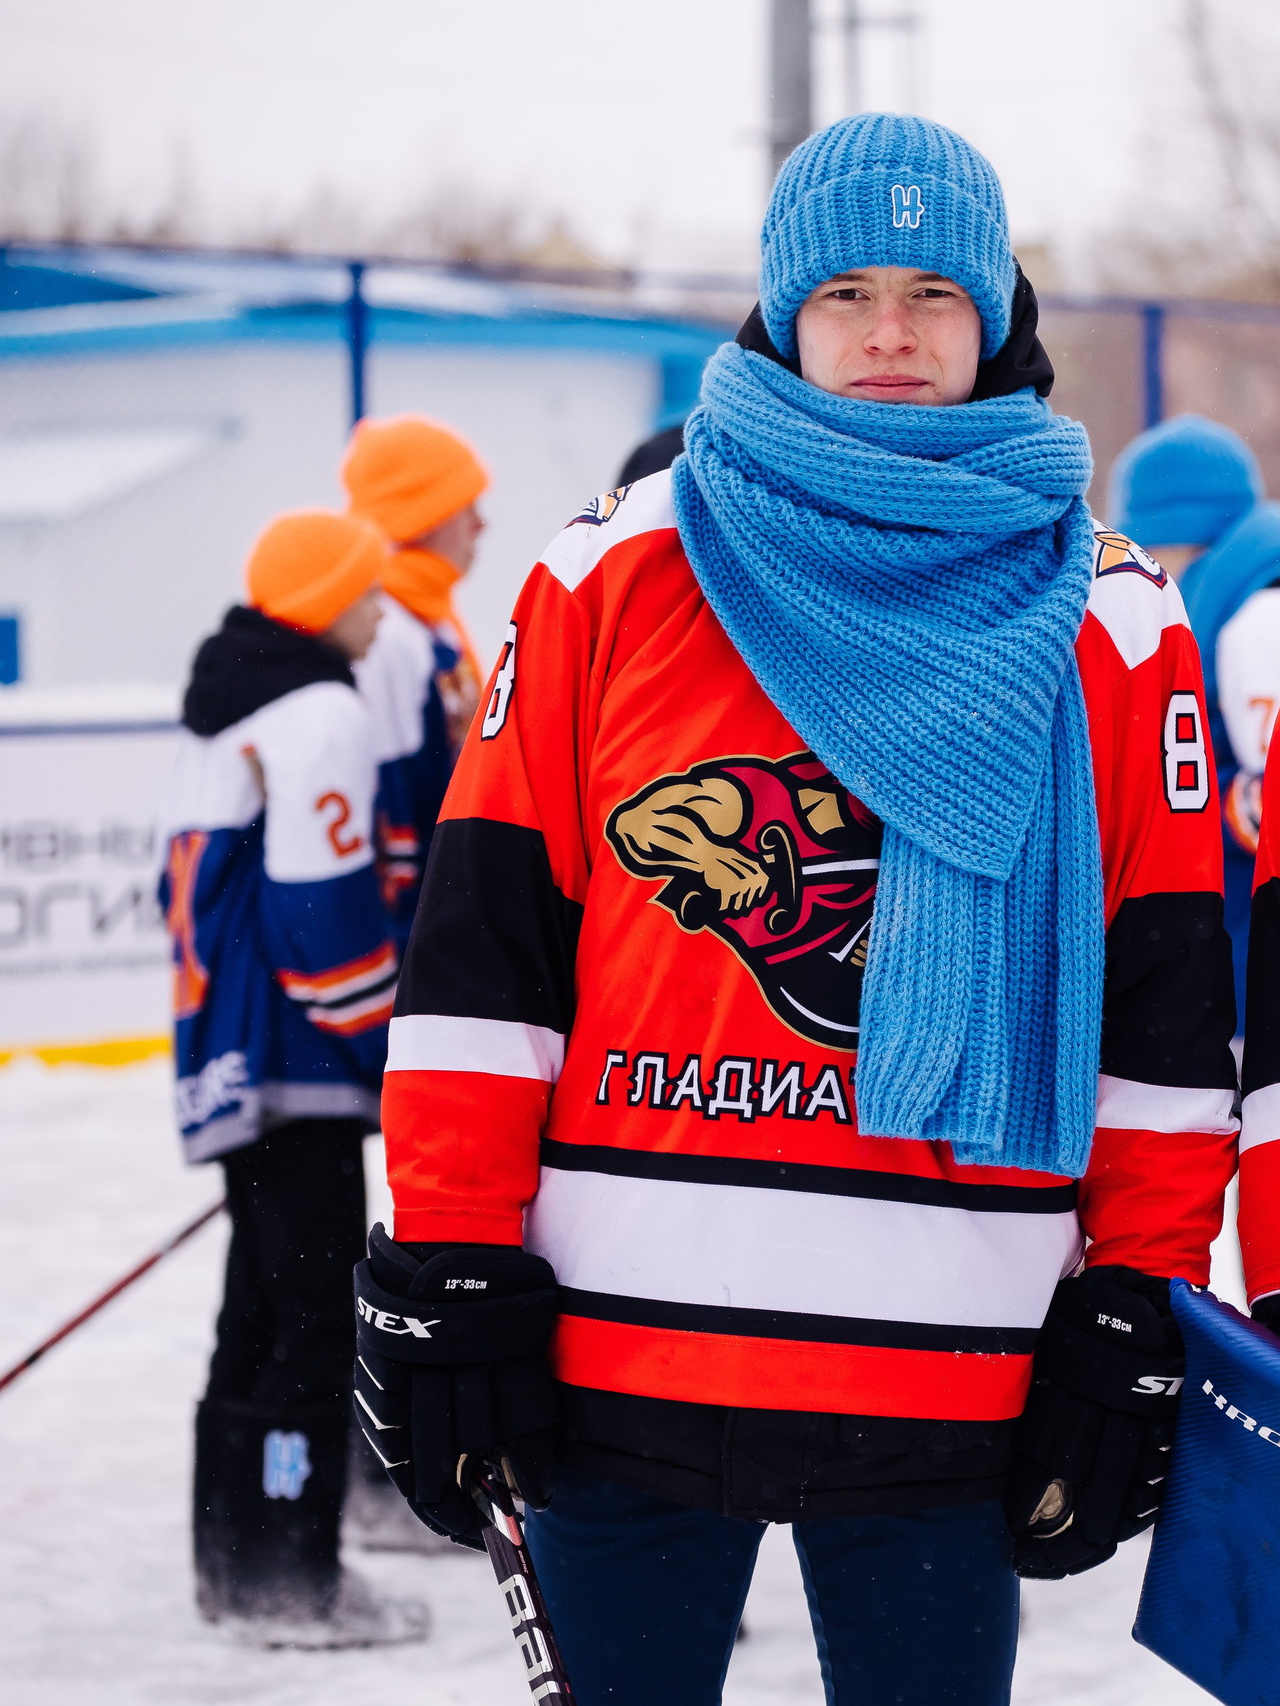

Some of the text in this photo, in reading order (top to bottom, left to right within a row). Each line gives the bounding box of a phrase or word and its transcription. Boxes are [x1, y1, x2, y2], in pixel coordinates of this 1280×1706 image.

[1161, 690, 1210, 814] 8
[596, 1050, 856, 1125] ГЛАДИА
[357, 1296, 442, 1338] STEX
[1131, 1375, 1184, 1396] ST
